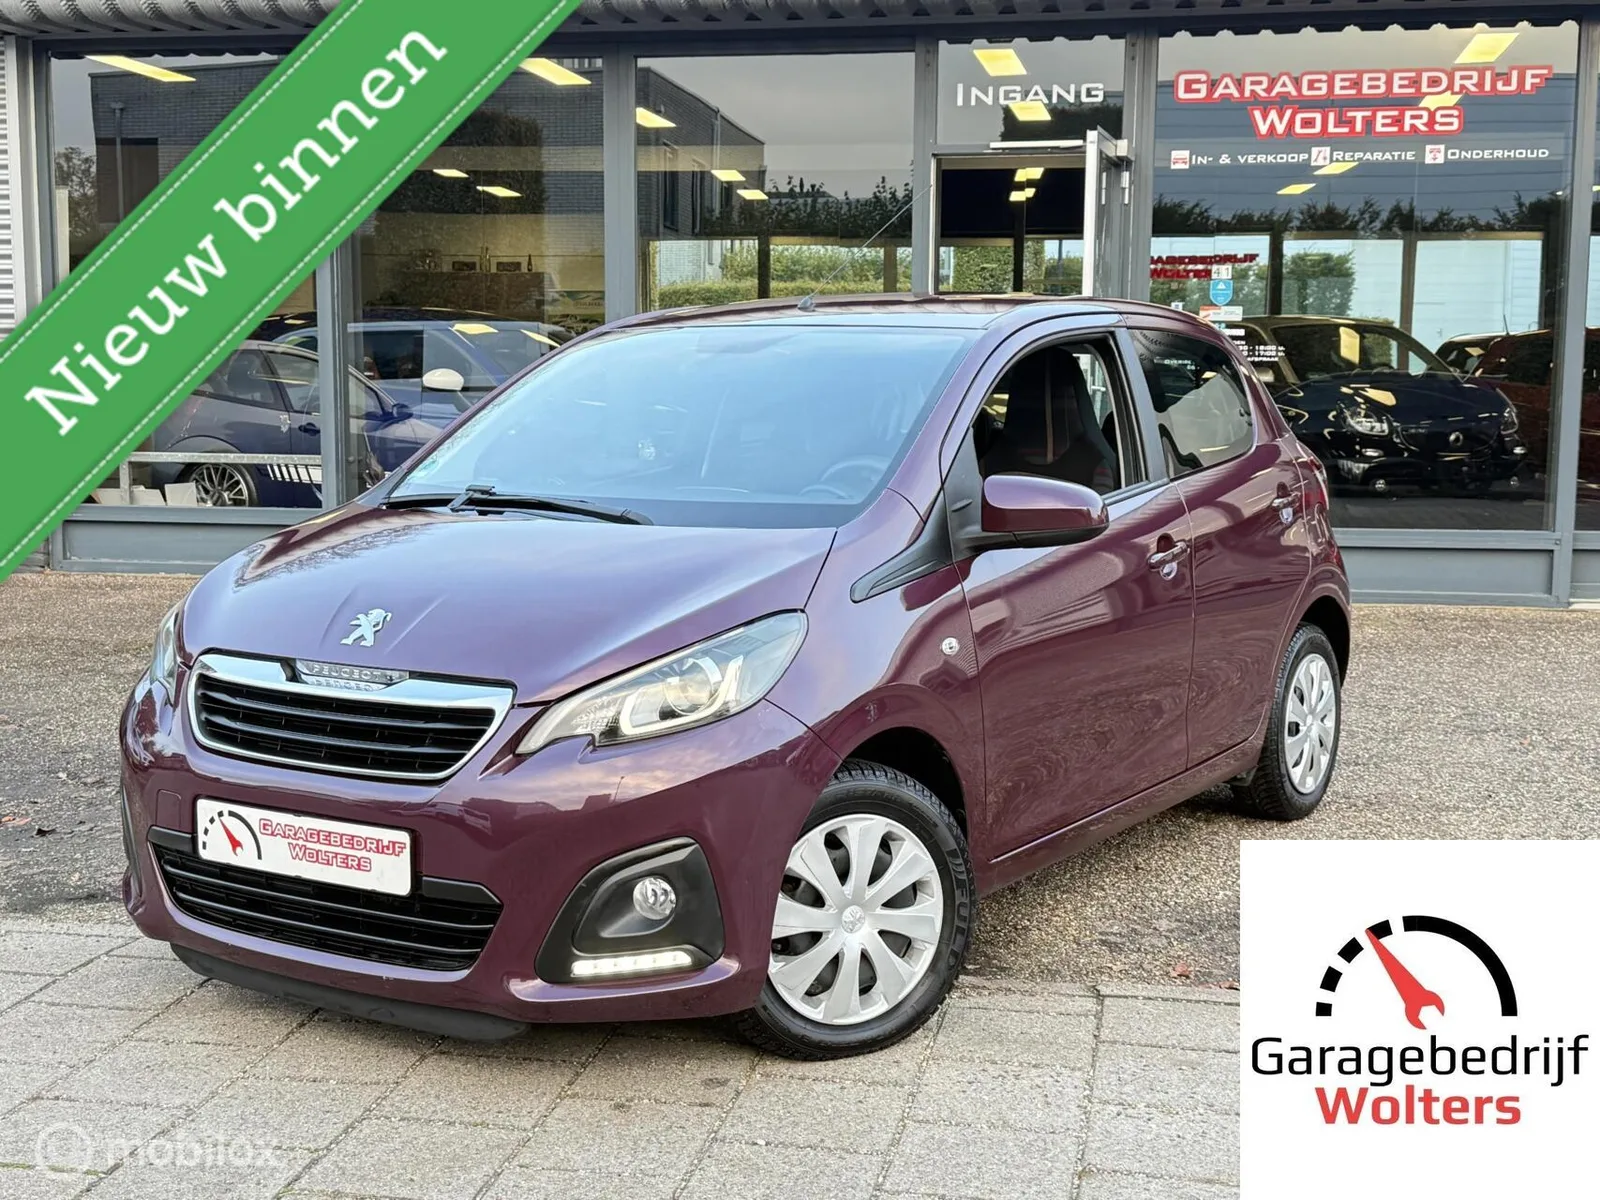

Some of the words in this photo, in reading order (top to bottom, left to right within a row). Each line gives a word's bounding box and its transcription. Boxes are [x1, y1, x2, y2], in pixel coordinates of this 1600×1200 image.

[956, 83, 1105, 107] INGANG
[1175, 65, 1552, 102] GARAGEBEDRIJF
[1248, 105, 1464, 139] WOLTERS
[1219, 153, 1232, 164] &
[1237, 152, 1309, 165] VERKOOP
[1332, 150, 1417, 162] REPARATIE
[1446, 148, 1550, 159] ONDERHOUD
[312, 664, 381, 681] PEUGEOT
[259, 818, 407, 857] GARAGEBEDRIJF
[288, 842, 372, 872] WOLTERS
